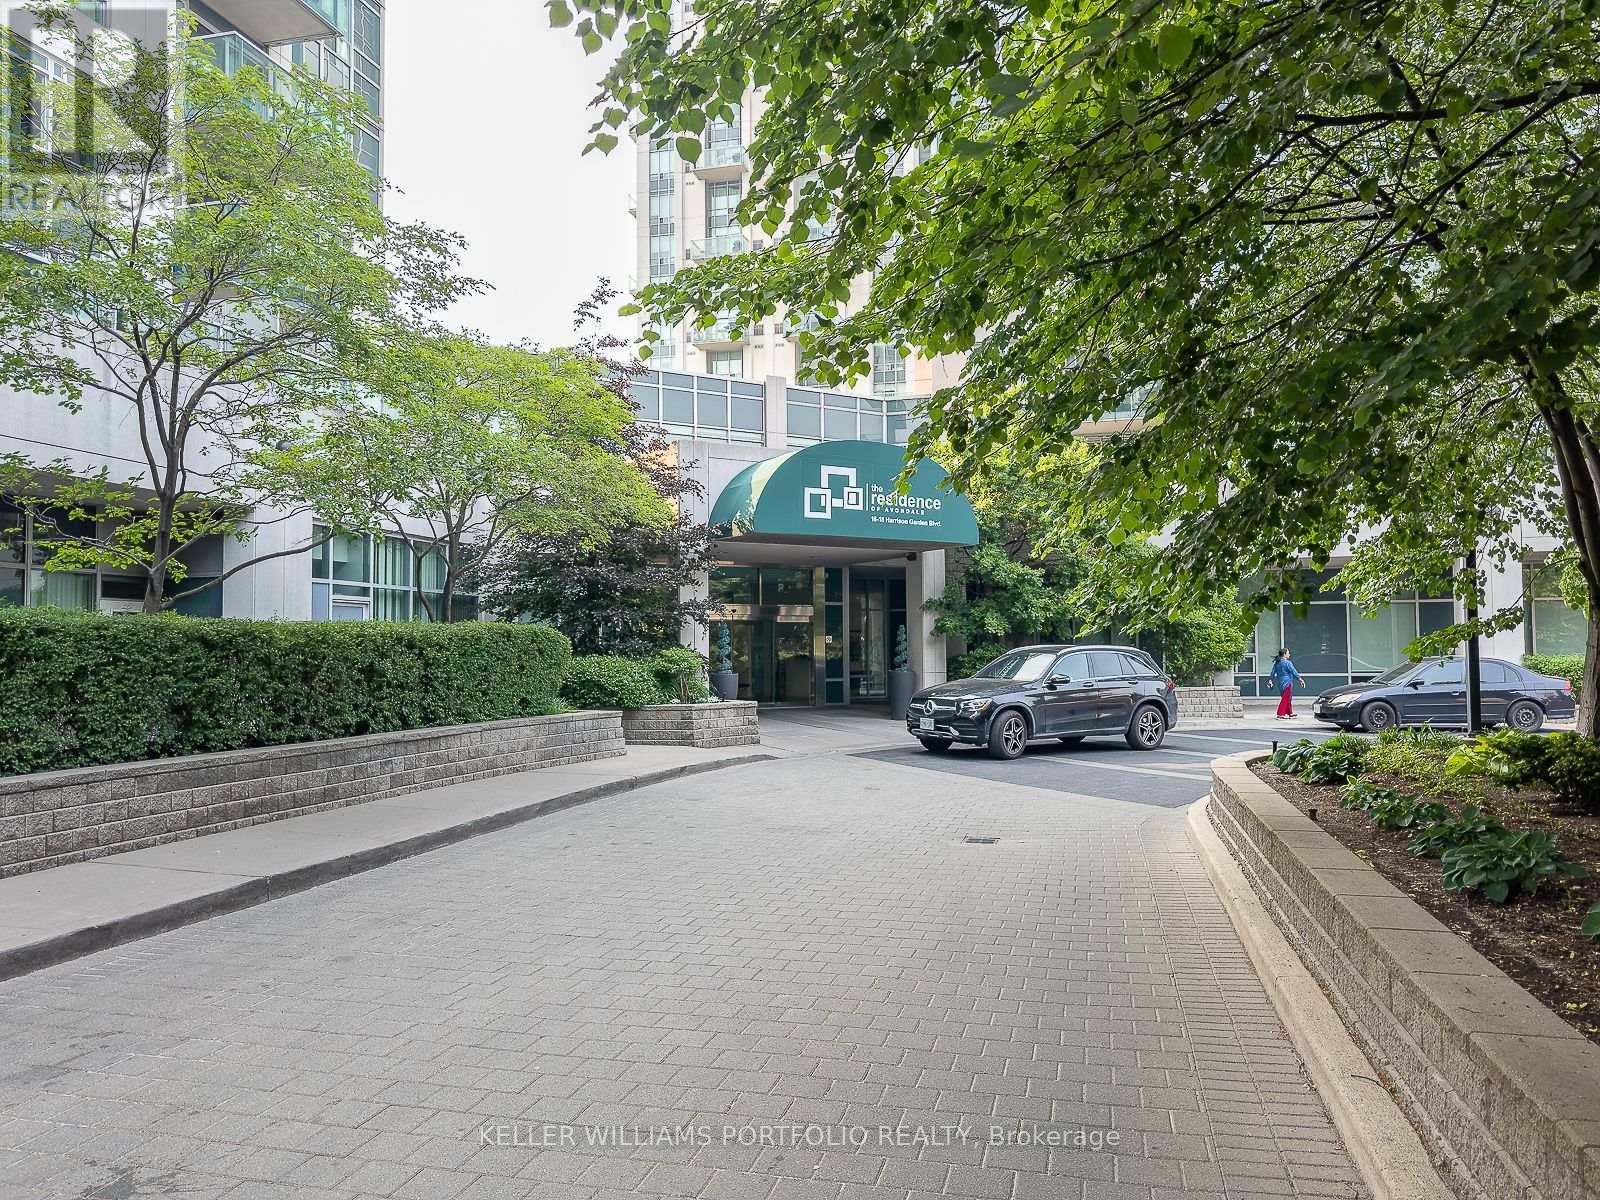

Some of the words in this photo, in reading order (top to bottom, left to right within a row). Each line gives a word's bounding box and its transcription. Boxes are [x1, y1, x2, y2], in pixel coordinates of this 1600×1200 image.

[871, 484, 883, 493] the
[871, 492, 942, 510] residence
[884, 507, 925, 515] AVONDALE
[886, 517, 908, 525] Harrison
